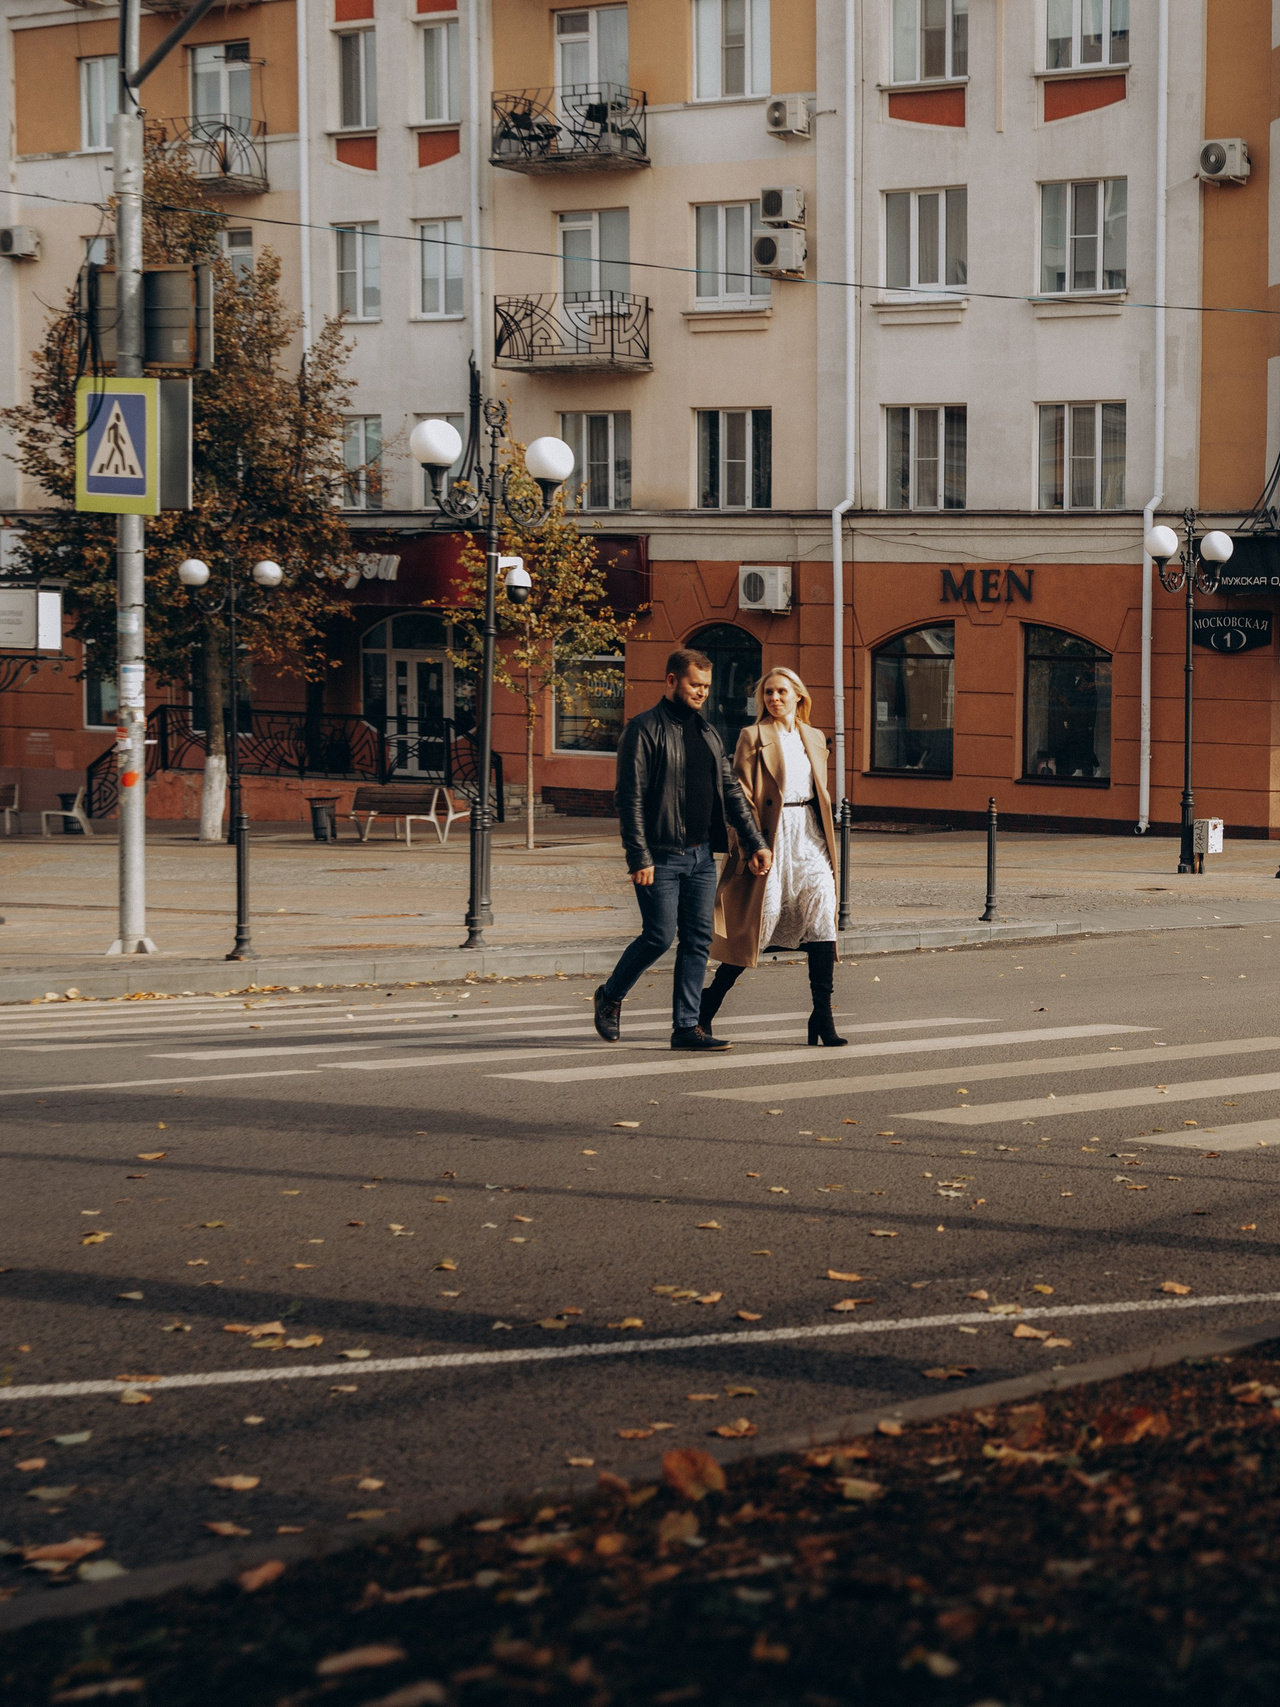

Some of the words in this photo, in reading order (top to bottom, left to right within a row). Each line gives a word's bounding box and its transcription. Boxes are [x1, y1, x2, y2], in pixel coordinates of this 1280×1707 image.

[939, 569, 1034, 602] MEN
[1221, 576, 1267, 586] МУЖСКАЯ
[1194, 616, 1268, 631] МОСКОВСКАЯ
